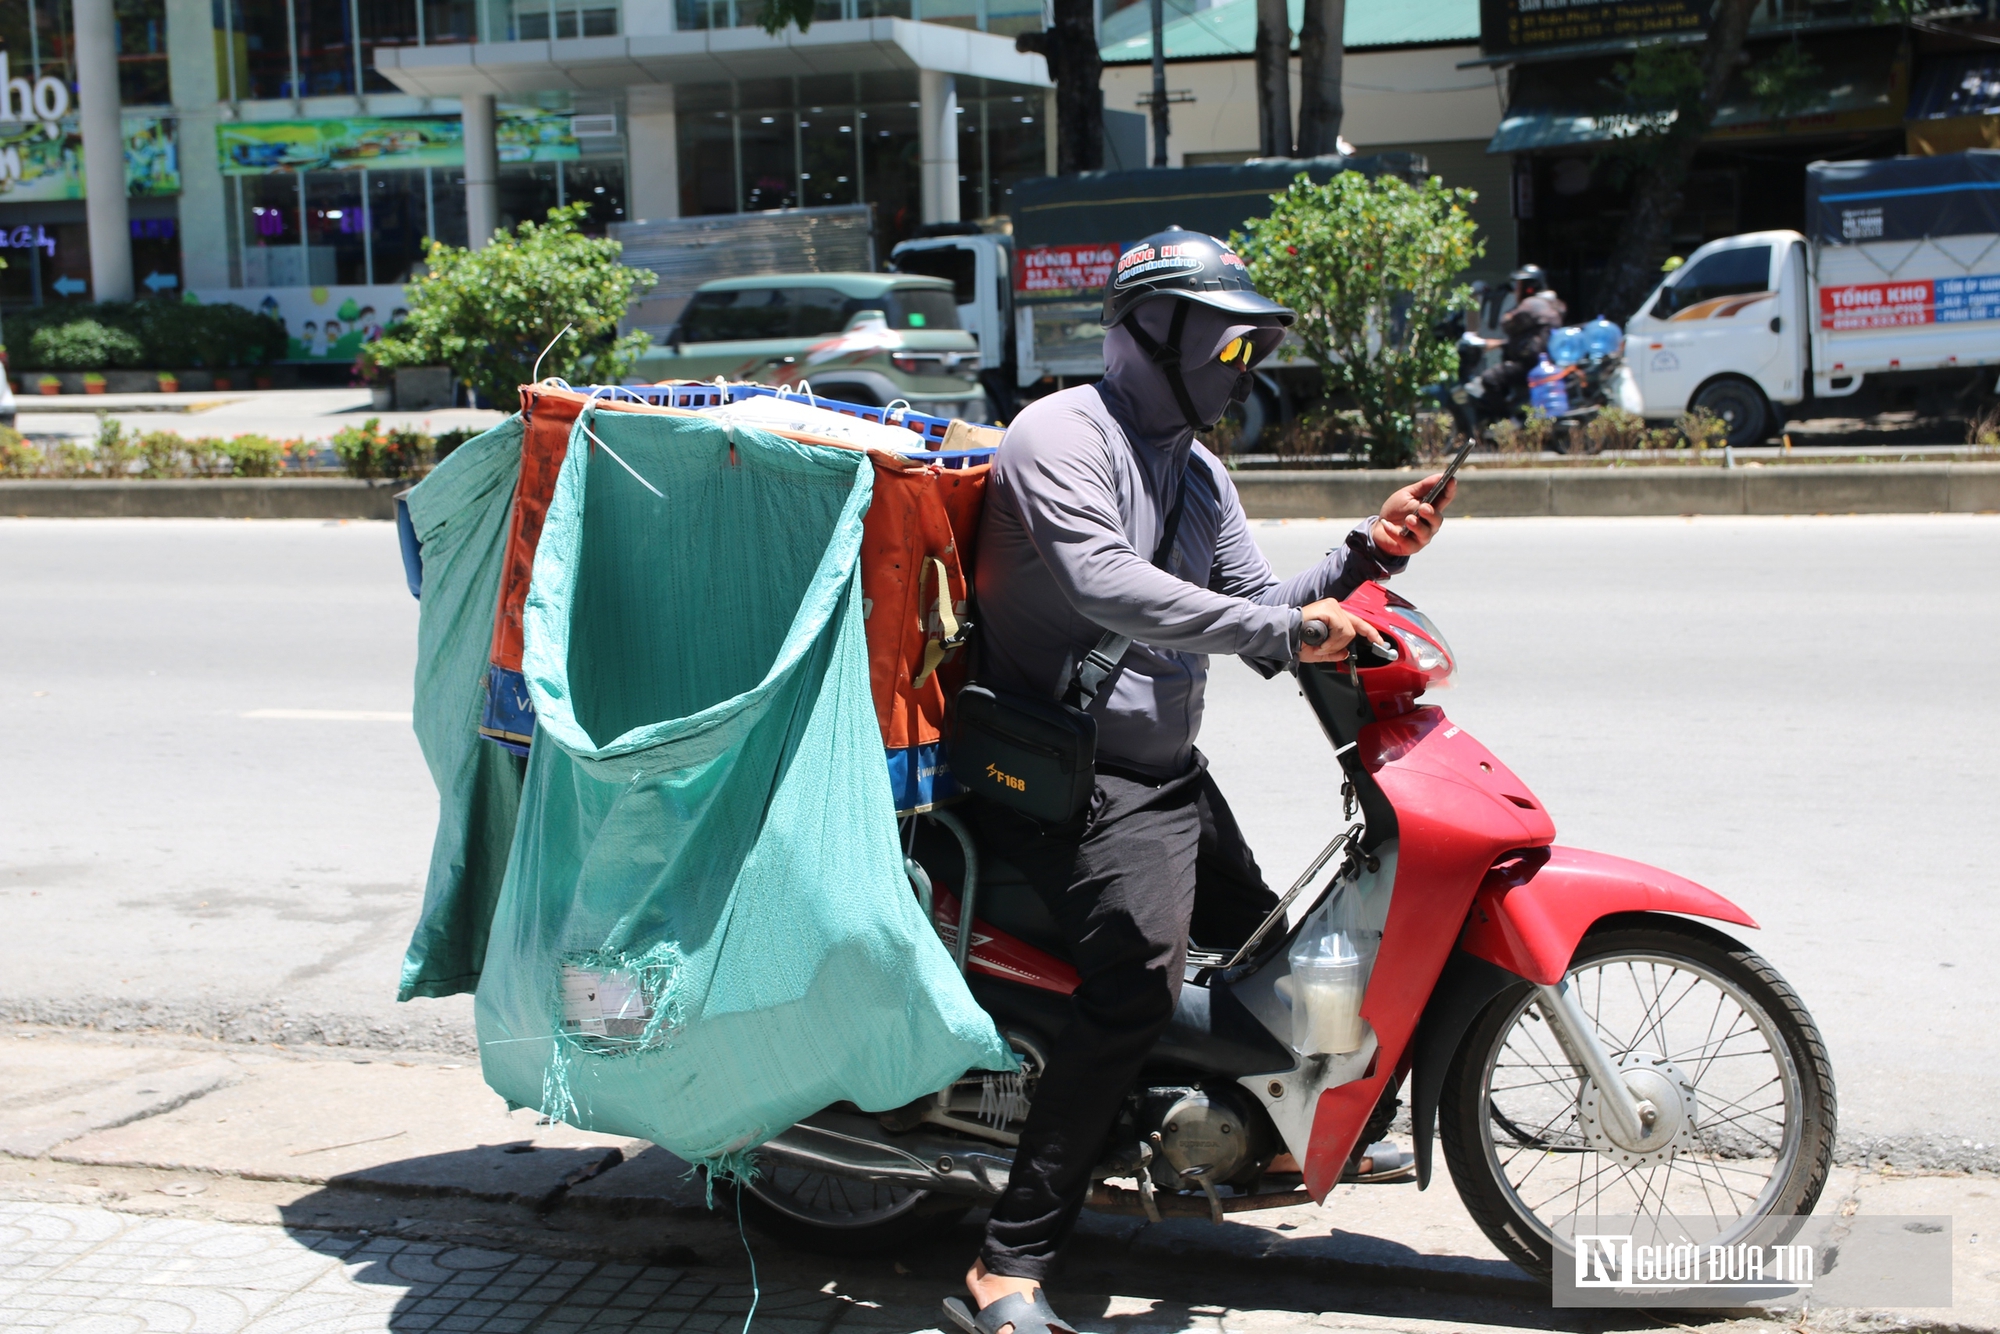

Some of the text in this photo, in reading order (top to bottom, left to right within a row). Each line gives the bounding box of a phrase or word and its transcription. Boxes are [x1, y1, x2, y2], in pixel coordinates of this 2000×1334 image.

[1831, 286, 1927, 308] TỔNG KHO
[997, 770, 1026, 792] F168
